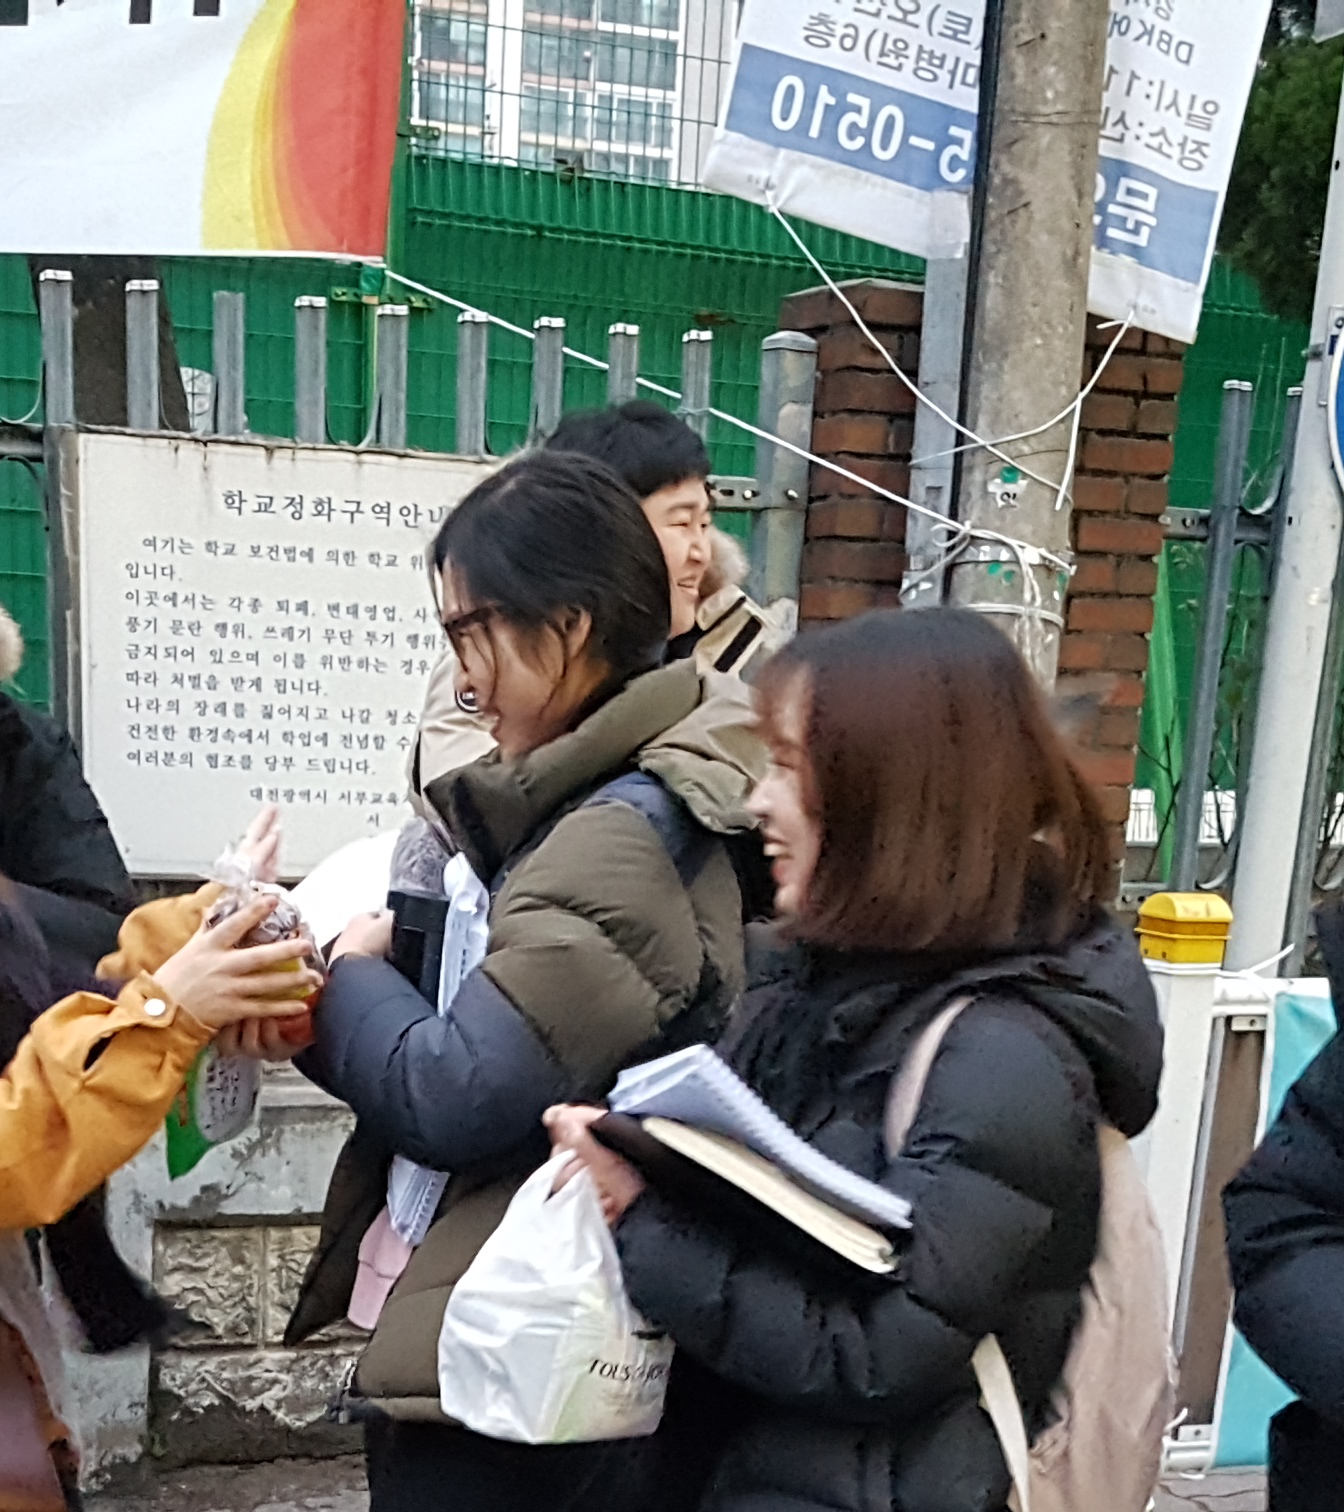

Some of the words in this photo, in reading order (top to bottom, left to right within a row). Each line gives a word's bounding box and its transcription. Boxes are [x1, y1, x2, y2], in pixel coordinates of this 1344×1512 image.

[143, 535, 194, 555] 여기는
[205, 540, 237, 557] 학교
[249, 544, 314, 563] 보건법에
[326, 549, 356, 567] 의한
[368, 552, 398, 568] 학교
[125, 561, 182, 581] 입니다.
[125, 588, 217, 610] 이곳에서는
[229, 596, 263, 614] 각종
[125, 616, 157, 634] 풍기
[169, 618, 202, 637] 문란
[263, 625, 311, 644] 쓰레기
[323, 628, 353, 646] 무단
[364, 630, 394, 648] 투기
[125, 643, 195, 664] 금지되어
[209, 648, 259, 667] 있으며
[273, 652, 306, 670] 이를
[321, 653, 387, 674] 위반하는
[126, 670, 158, 688] 따라
[170, 672, 219, 691] 처벌을
[230, 676, 262, 693] 받게
[126, 696, 179, 715] 나라의
[194, 699, 246, 719] 장래를
[341, 707, 372, 725] 나갈
[281, 730, 328, 747] 학업에
[127, 749, 193, 769] 여러분의
[206, 752, 253, 771] 협조를
[264, 755, 296, 772] 당부
[306, 758, 376, 776] 드립니다.
[339, 789, 409, 806] 서부교육
